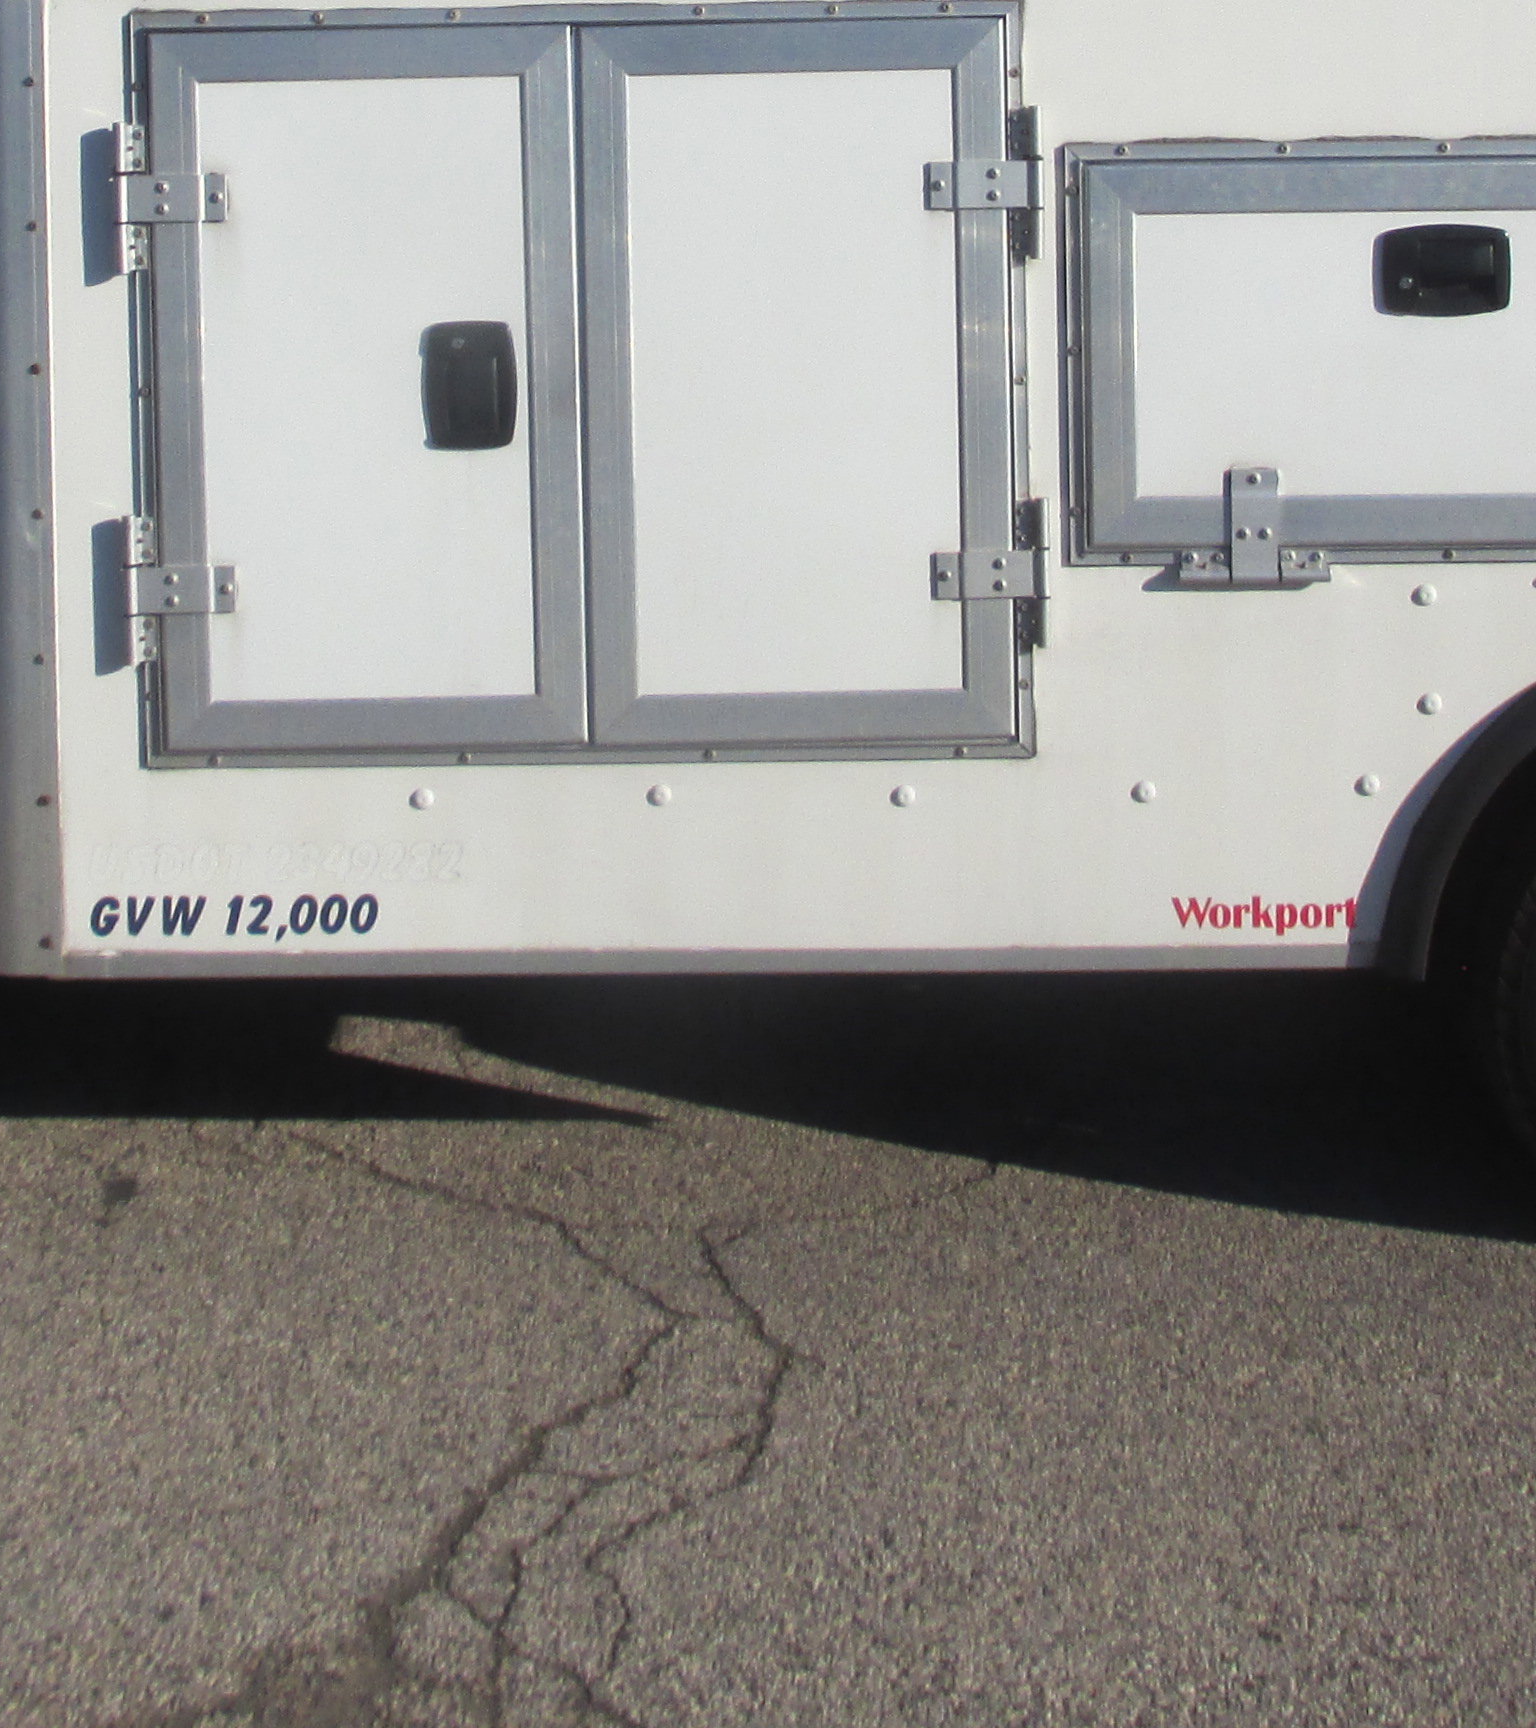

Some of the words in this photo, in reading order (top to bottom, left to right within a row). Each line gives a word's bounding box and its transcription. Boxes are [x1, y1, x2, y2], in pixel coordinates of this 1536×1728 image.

[89, 894, 207, 937] GVW
[224, 892, 380, 943] 12,000
[1171, 895, 1358, 936] Workport
